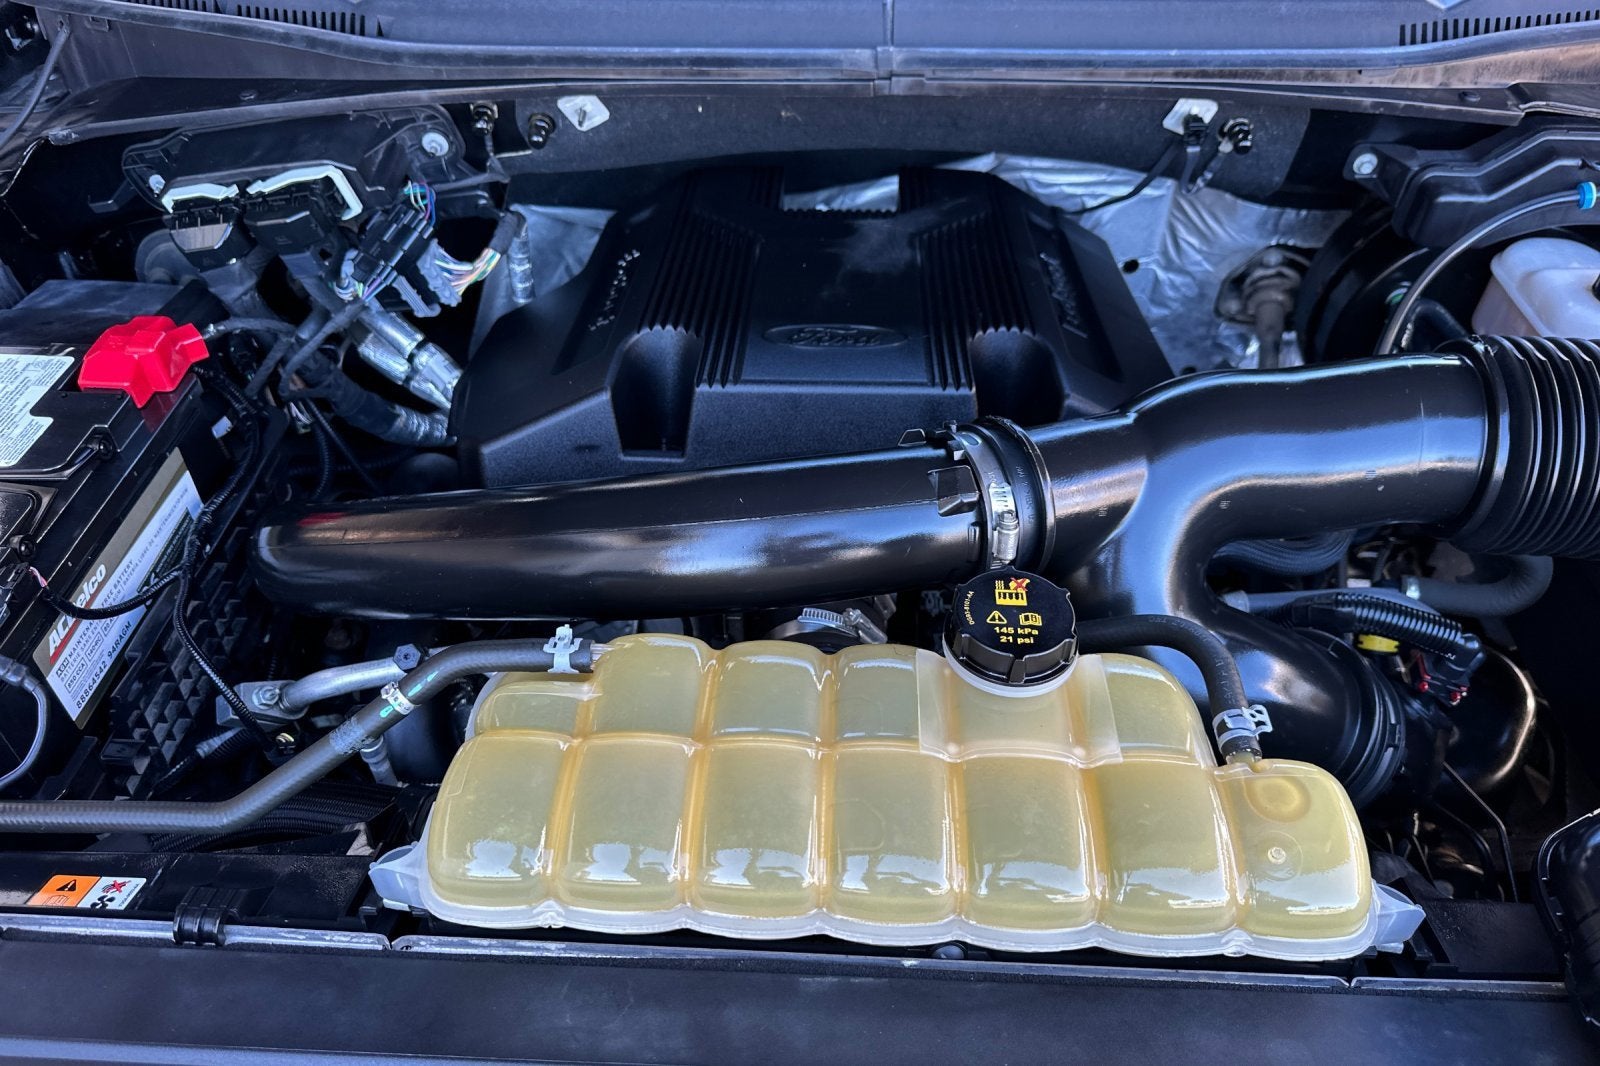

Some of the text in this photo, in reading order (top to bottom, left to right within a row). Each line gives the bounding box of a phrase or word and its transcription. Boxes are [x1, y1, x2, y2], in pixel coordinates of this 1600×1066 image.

[789, 327, 881, 346] Ford
[69, 618, 94, 657] MAINTENA
[101, 588, 113, 608] FREE
[114, 560, 132, 588] BATTERY
[1018, 626, 1038, 635] kPa
[1018, 636, 1034, 644] psi
[76, 660, 106, 708] 88864542
[108, 620, 130, 659] 94RAGM
